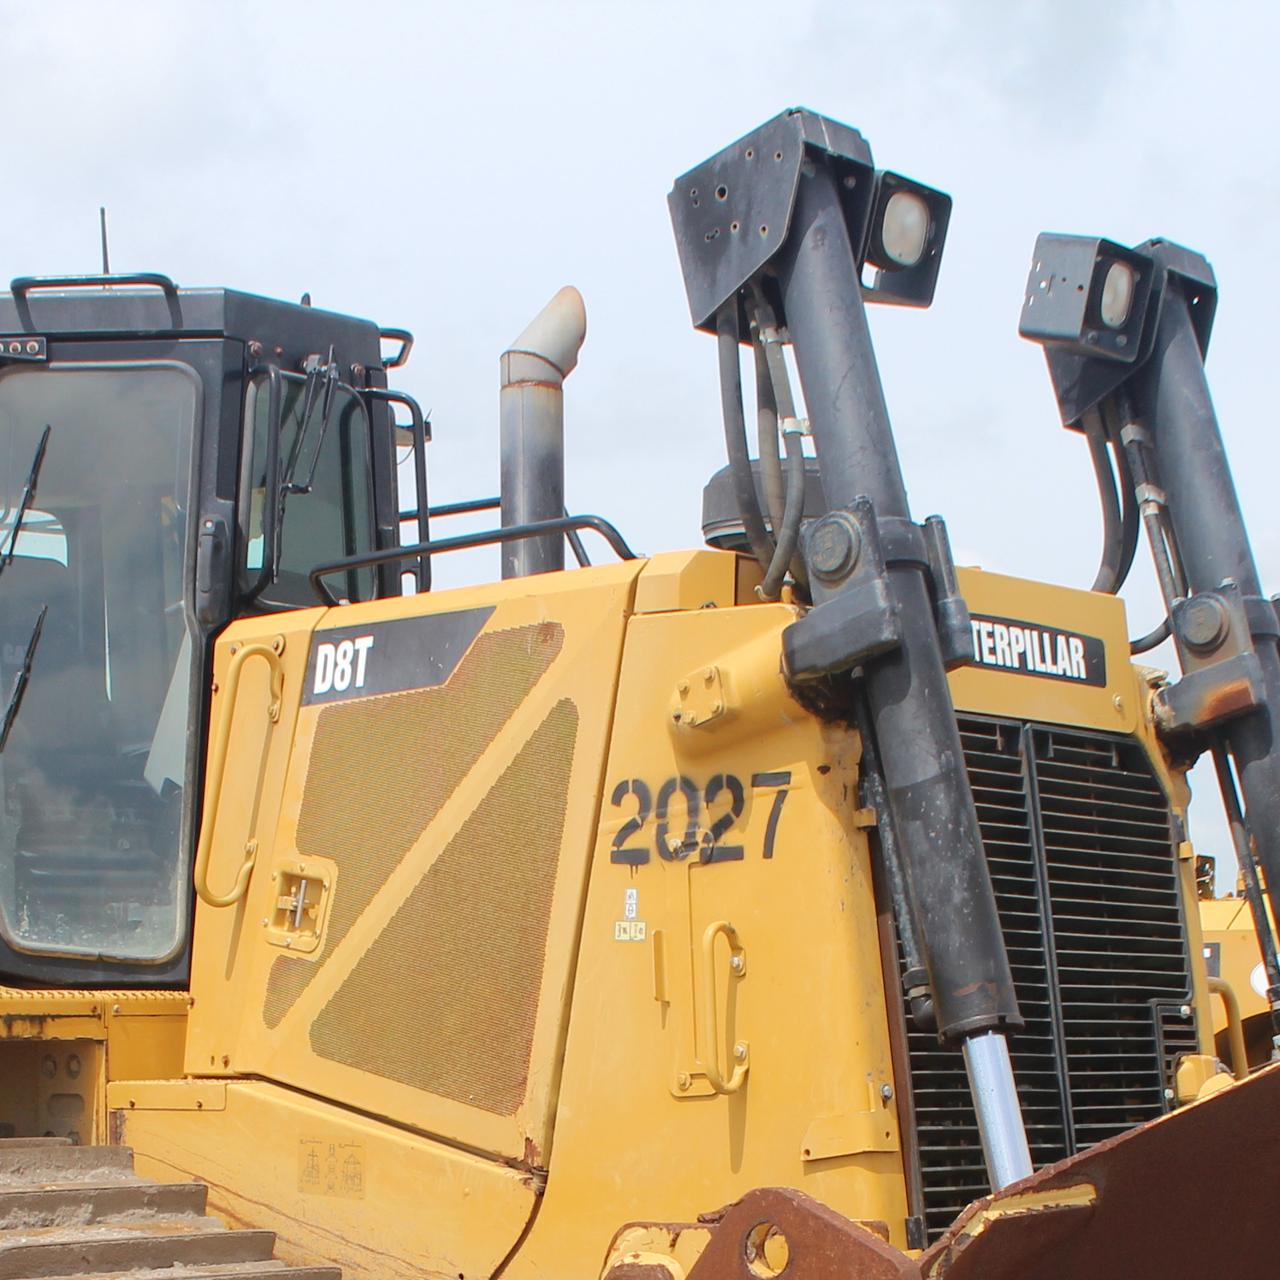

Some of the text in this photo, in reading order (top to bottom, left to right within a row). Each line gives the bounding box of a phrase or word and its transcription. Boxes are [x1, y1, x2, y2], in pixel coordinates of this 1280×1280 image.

[313, 635, 374, 694] D8T
[970, 619, 1087, 679] TERPILLAR
[610, 771, 791, 864] 2027
